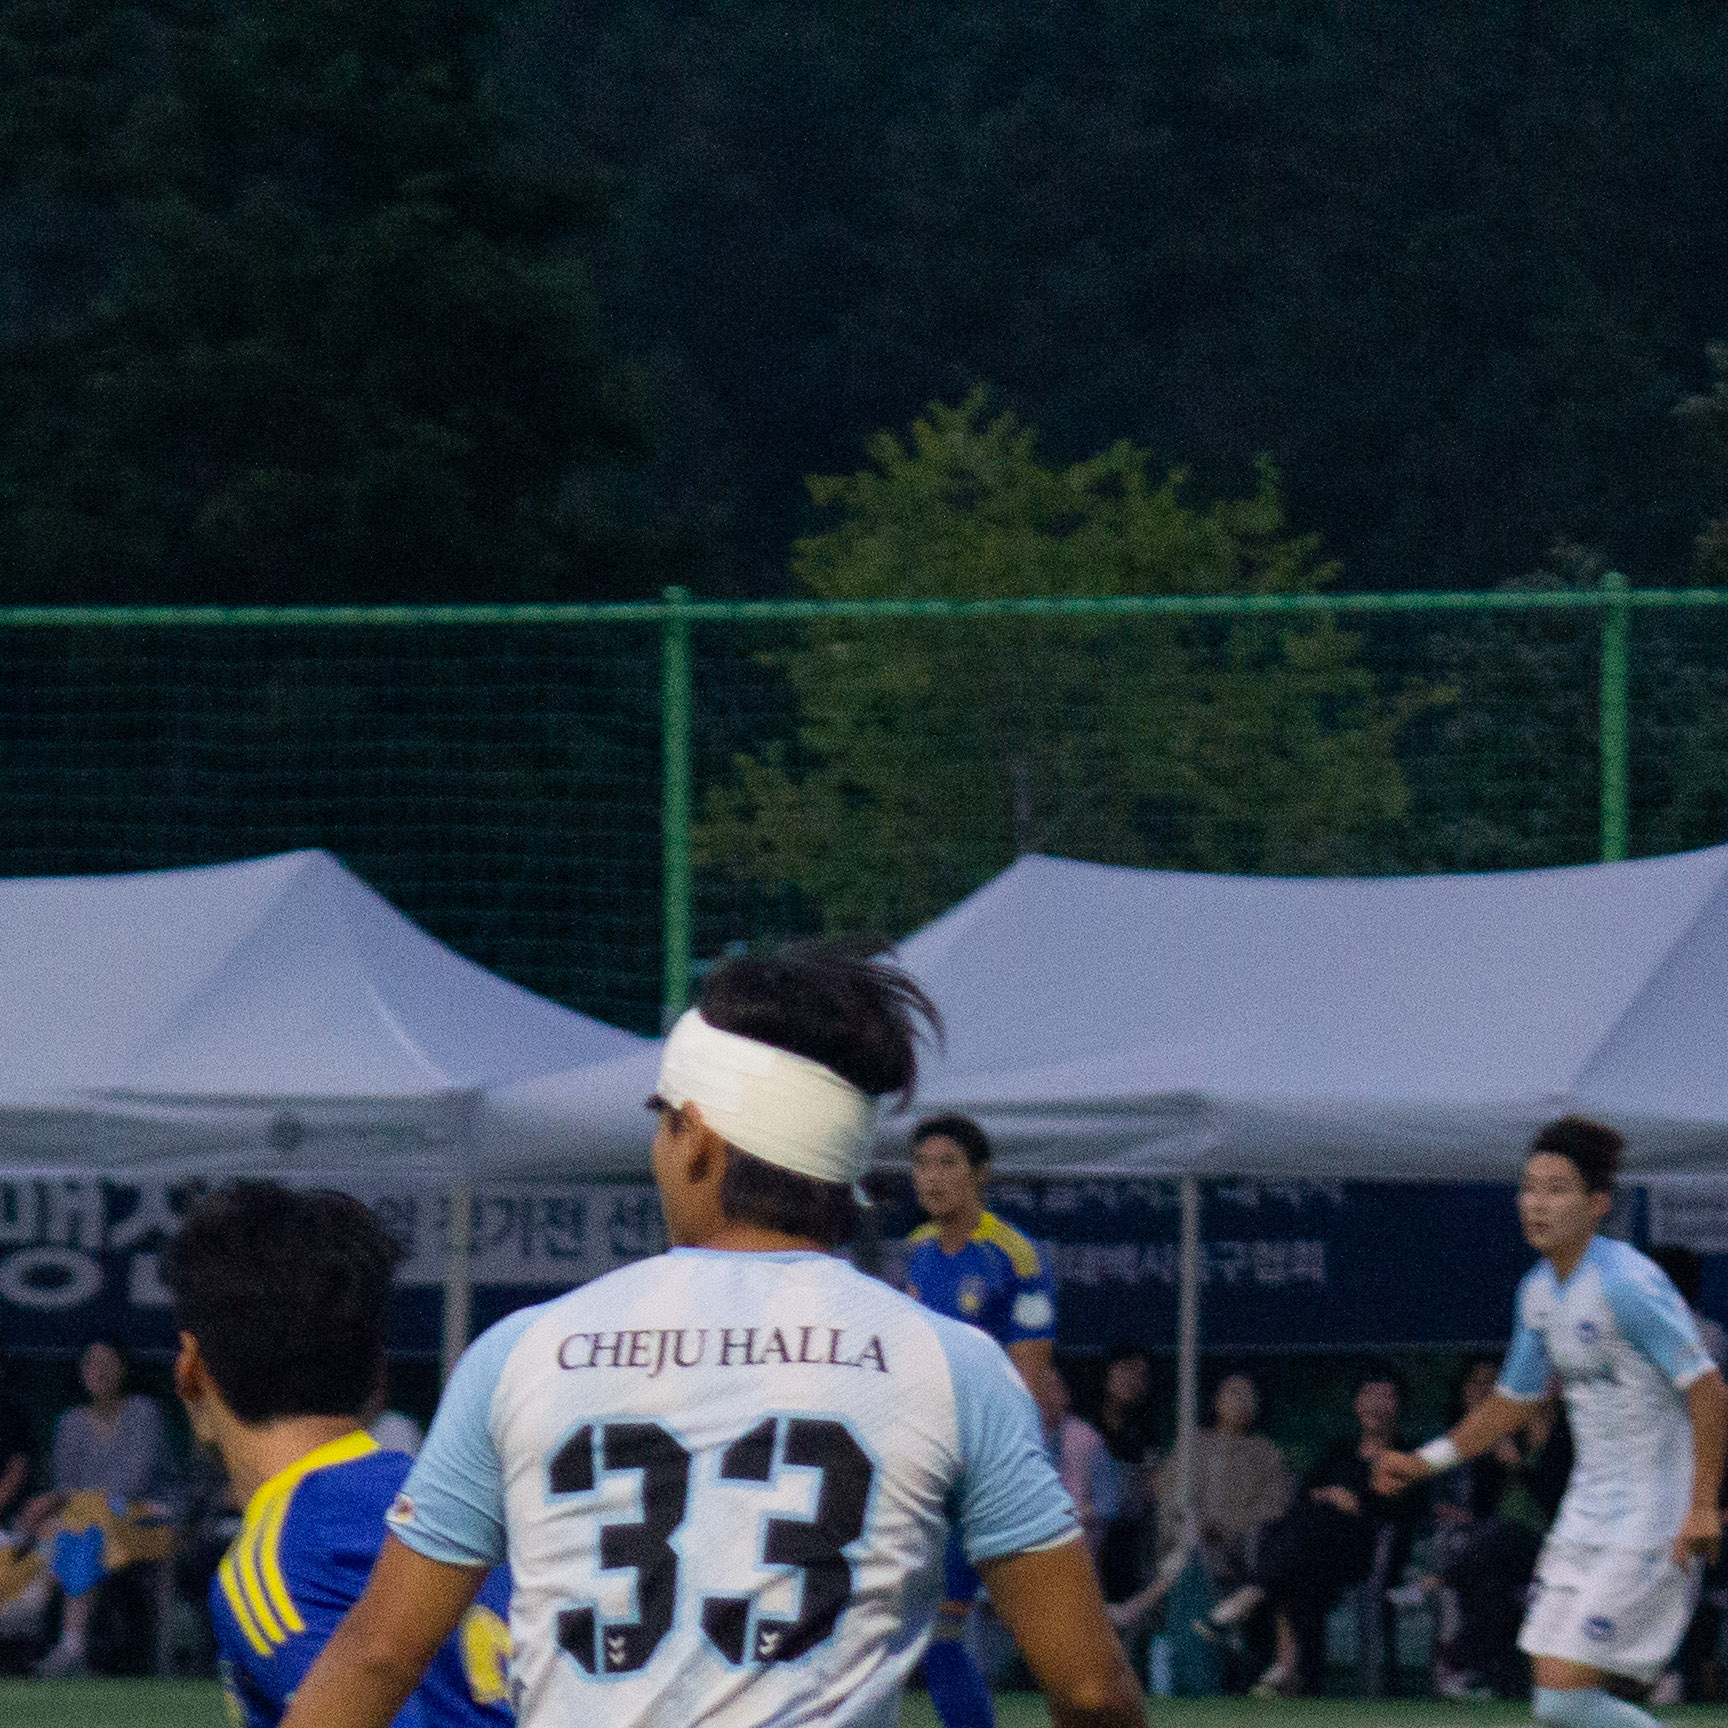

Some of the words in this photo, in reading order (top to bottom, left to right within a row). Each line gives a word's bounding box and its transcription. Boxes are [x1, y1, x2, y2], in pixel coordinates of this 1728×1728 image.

[556, 1327, 706, 1381] CHEJU
[716, 1325, 891, 1374] HALLA
[546, 1413, 878, 1679] 33
